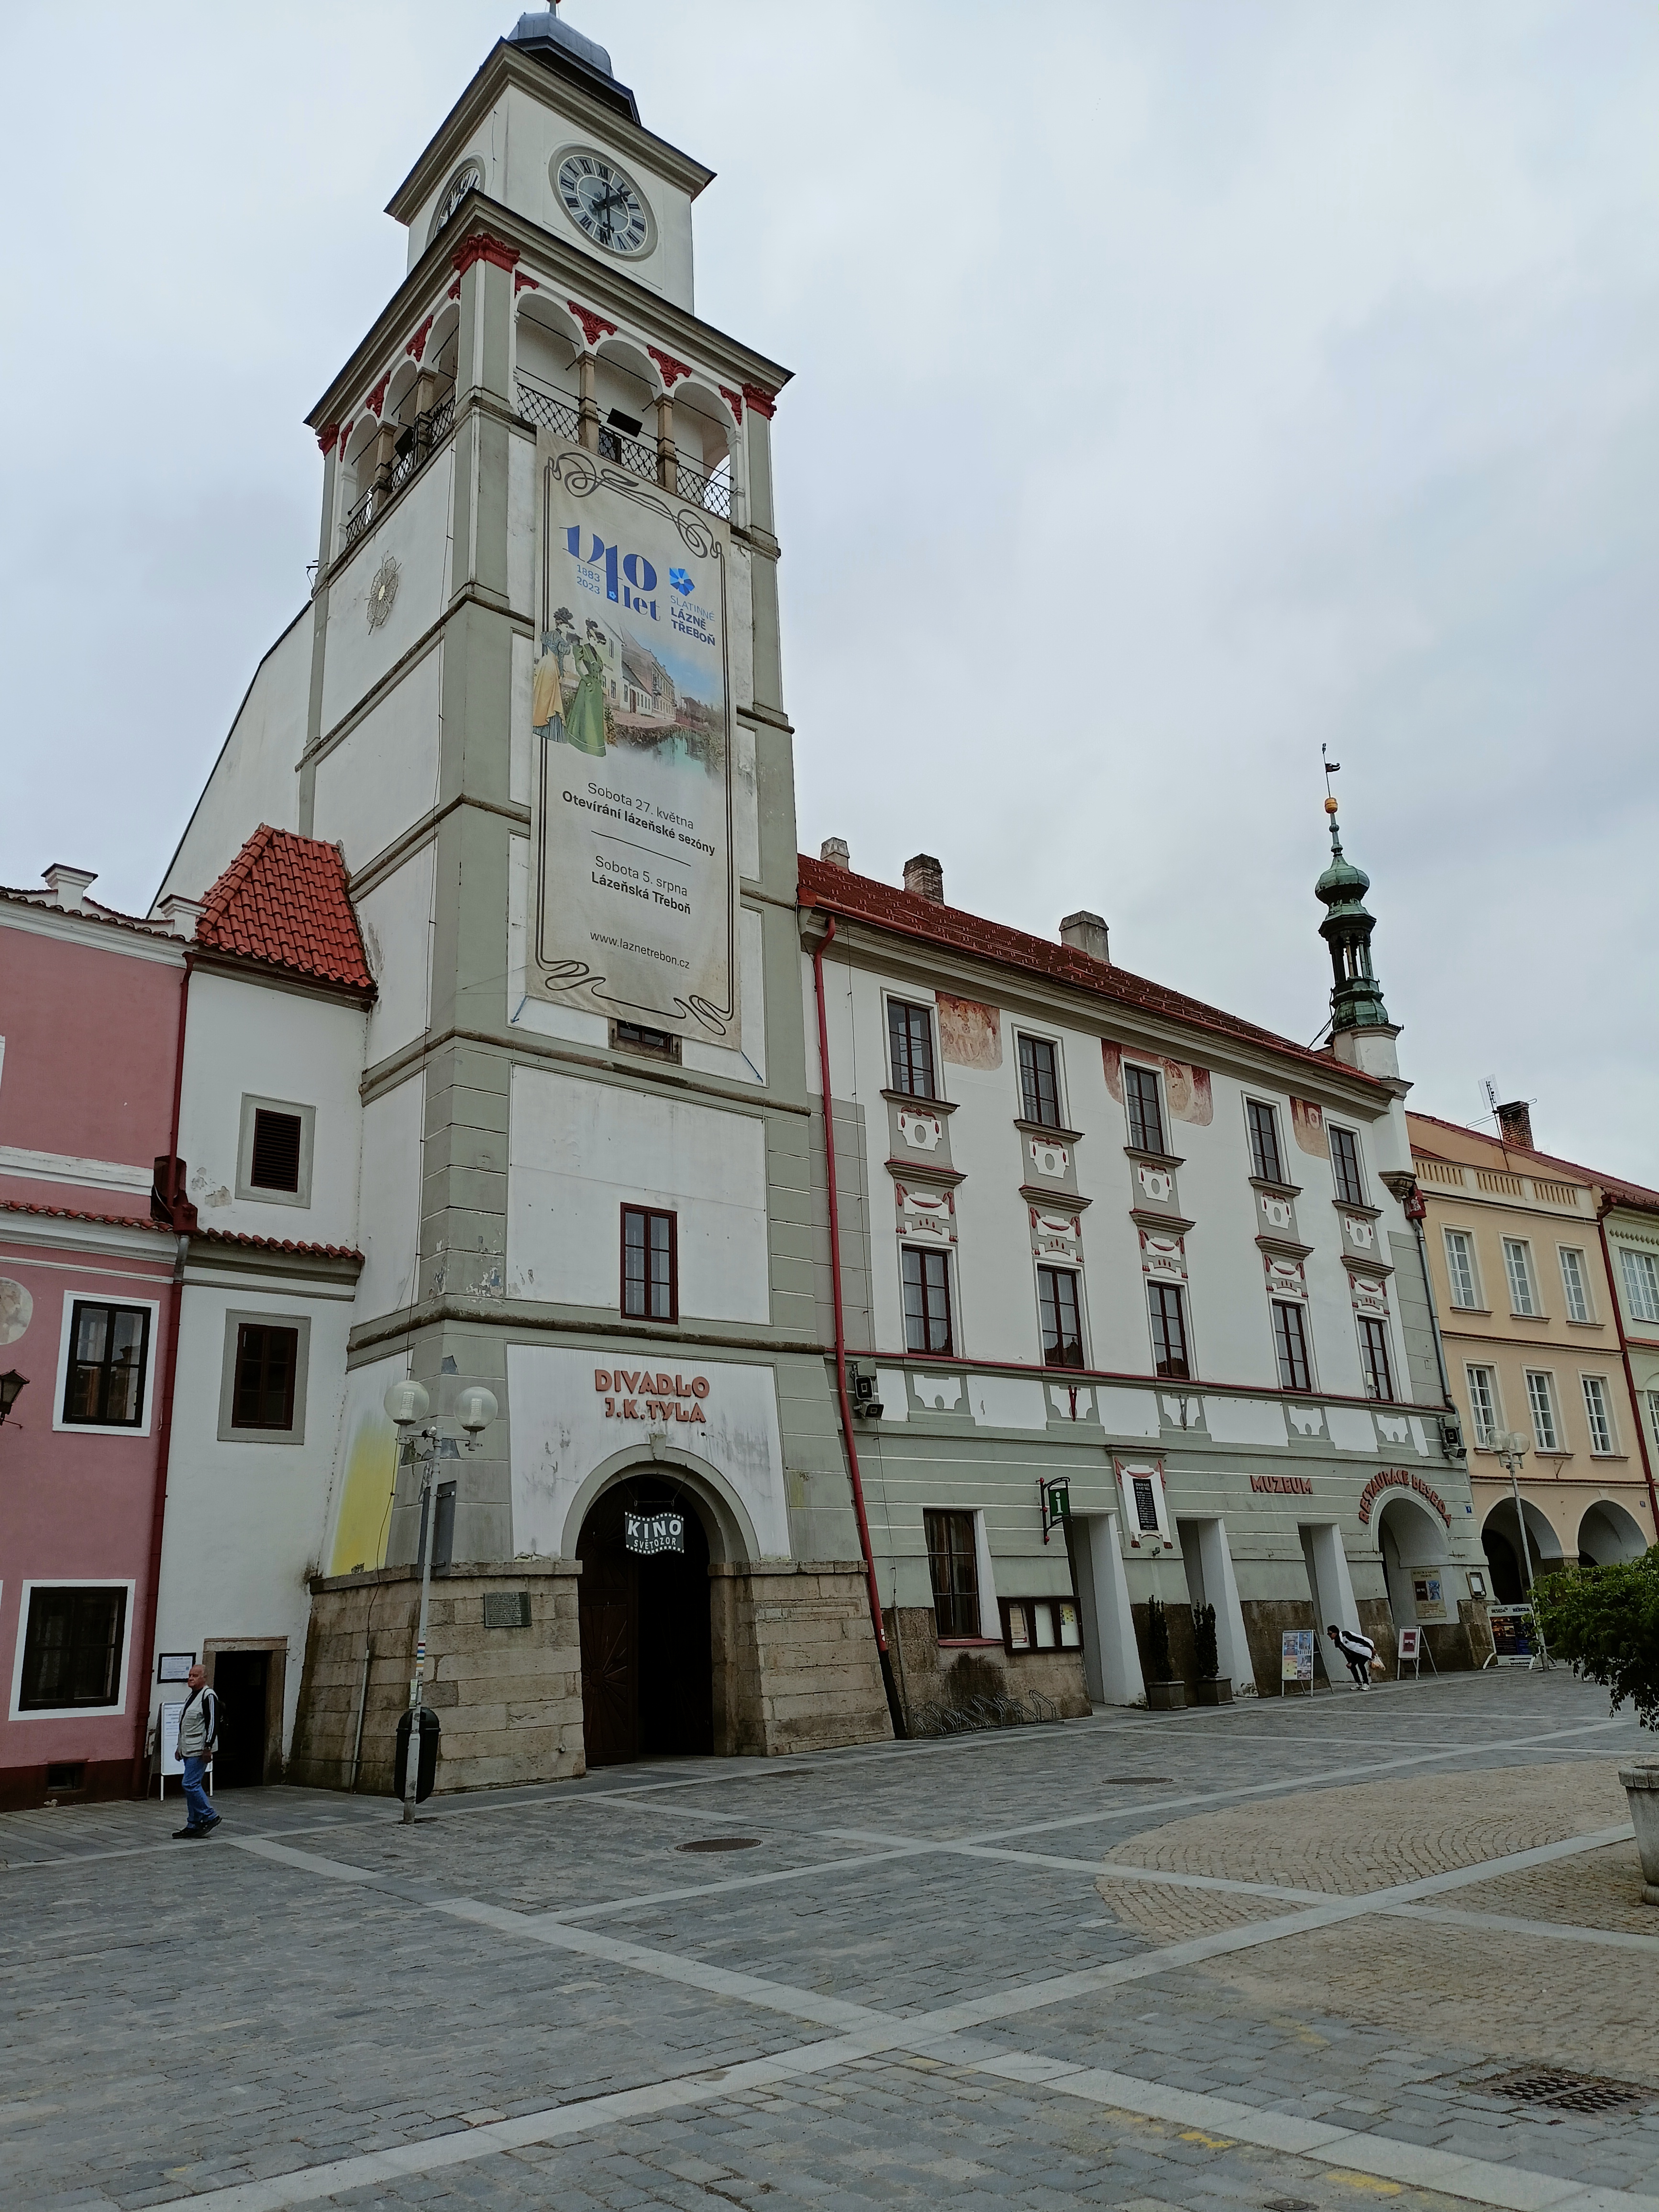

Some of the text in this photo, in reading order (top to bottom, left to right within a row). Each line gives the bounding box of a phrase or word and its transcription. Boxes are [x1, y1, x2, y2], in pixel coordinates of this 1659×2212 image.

[598, 164, 608, 180] XII
[559, 525, 657, 604] 140
[576, 564, 600, 582] 1883
[576, 576, 600, 595] 2023
[622, 584, 661, 621] let
[670, 595, 715, 621] SLATINNÉ
[671, 607, 706, 630] LÁZNĚ
[671, 619, 715, 646] TŘEBOŇ
[588, 783, 694, 830] Sobota 27. května
[562, 791, 715, 856] Otevírání lázeňské sezóny
[595, 855, 687, 896] Sobota 5. srpna
[591, 871, 690, 914] Lázeňská Třeboň
[590, 932, 690, 969] www.laznetrebon.cz
[595, 1369, 710, 1399] DIVADLO
[1250, 1475, 1314, 1494] MUZEUM
[1359, 1468, 1451, 1528] RESTAURACE BESEDA
[628, 1520, 681, 1538] KINO
[634, 1537, 676, 1549] SVĚTOZOR
